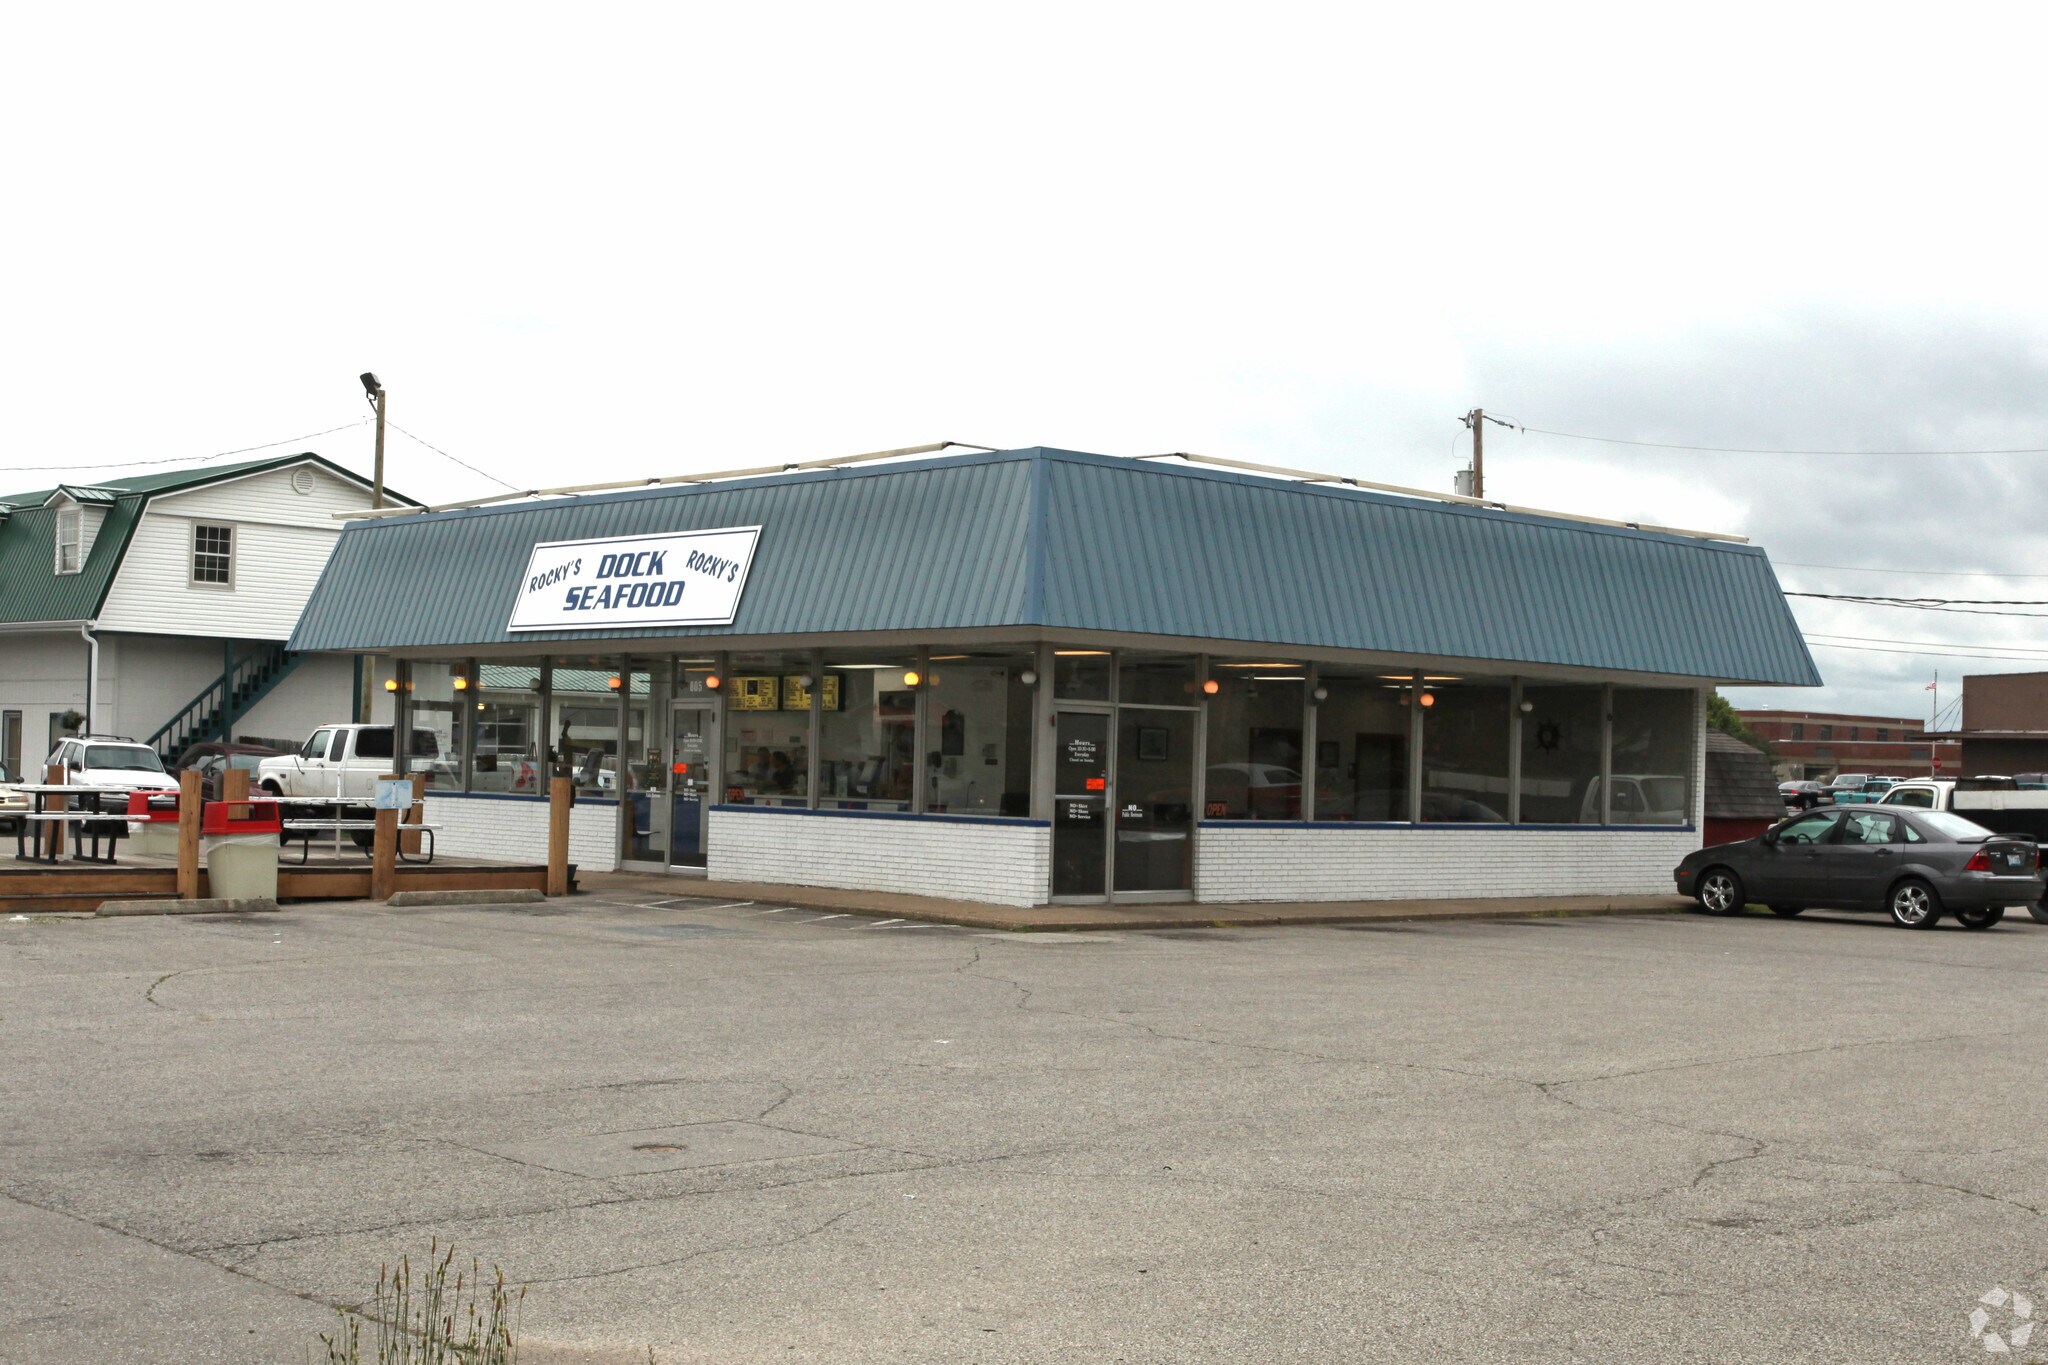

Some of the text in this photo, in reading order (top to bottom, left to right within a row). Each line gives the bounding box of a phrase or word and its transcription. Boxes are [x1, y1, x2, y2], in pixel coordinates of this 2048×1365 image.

[529, 558, 582, 593] ROCKY'S
[596, 550, 668, 579] DOCK
[686, 550, 739, 583] ROCKY'S
[563, 580, 686, 611] SEAFOOD
